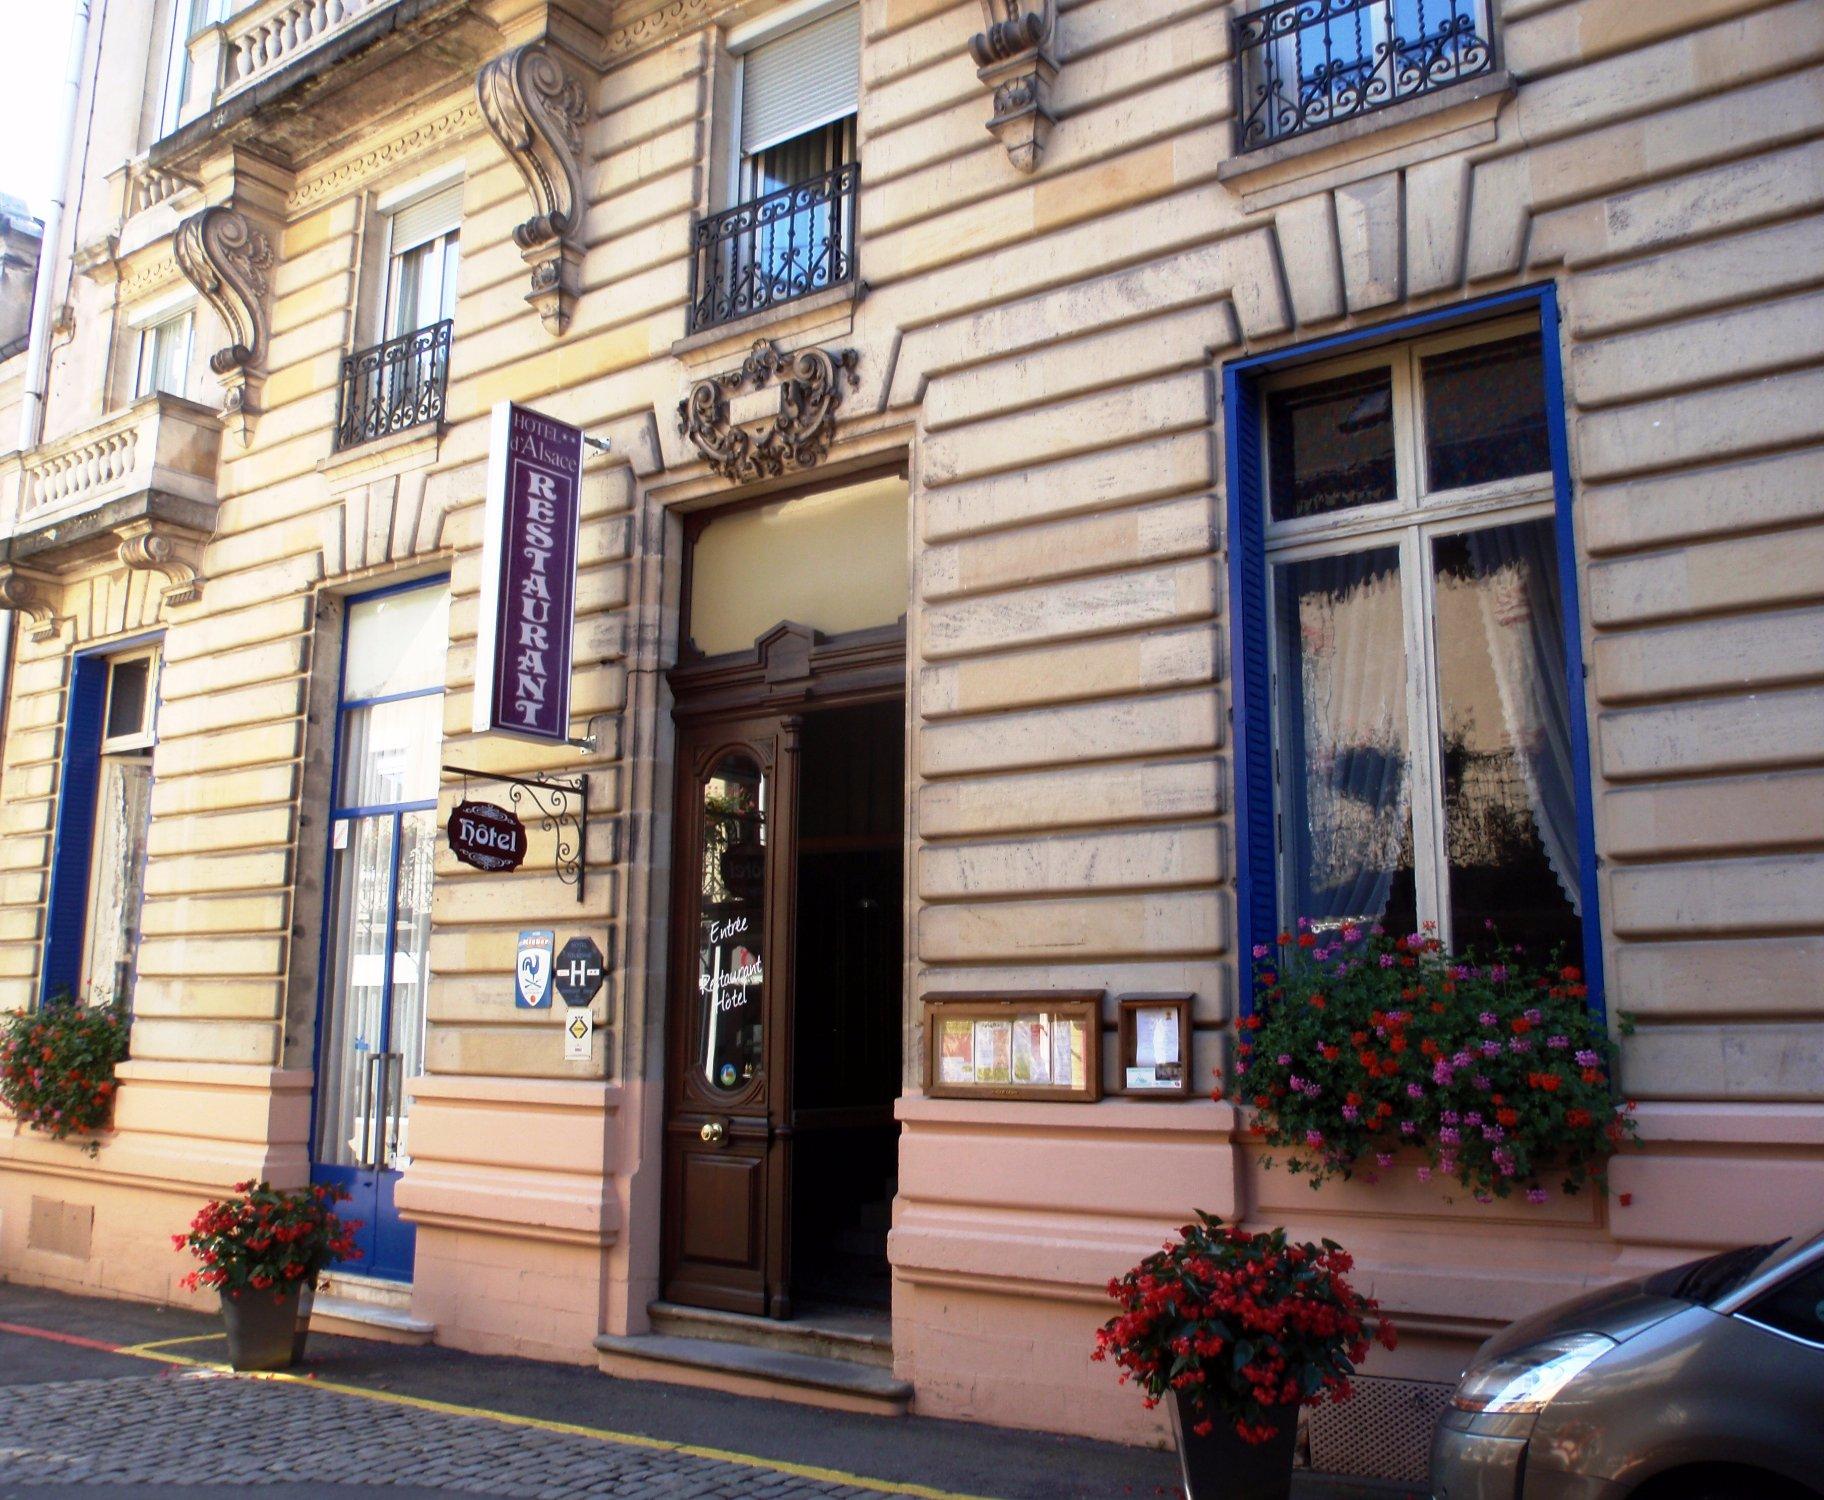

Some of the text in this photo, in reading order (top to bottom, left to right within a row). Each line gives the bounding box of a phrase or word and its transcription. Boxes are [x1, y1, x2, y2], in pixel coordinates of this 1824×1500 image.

[514, 413, 557, 442] HOTEL
[510, 434, 577, 473] d'Alsace
[515, 470, 557, 727] RESTAURANT
[570, 960, 586, 987] H
